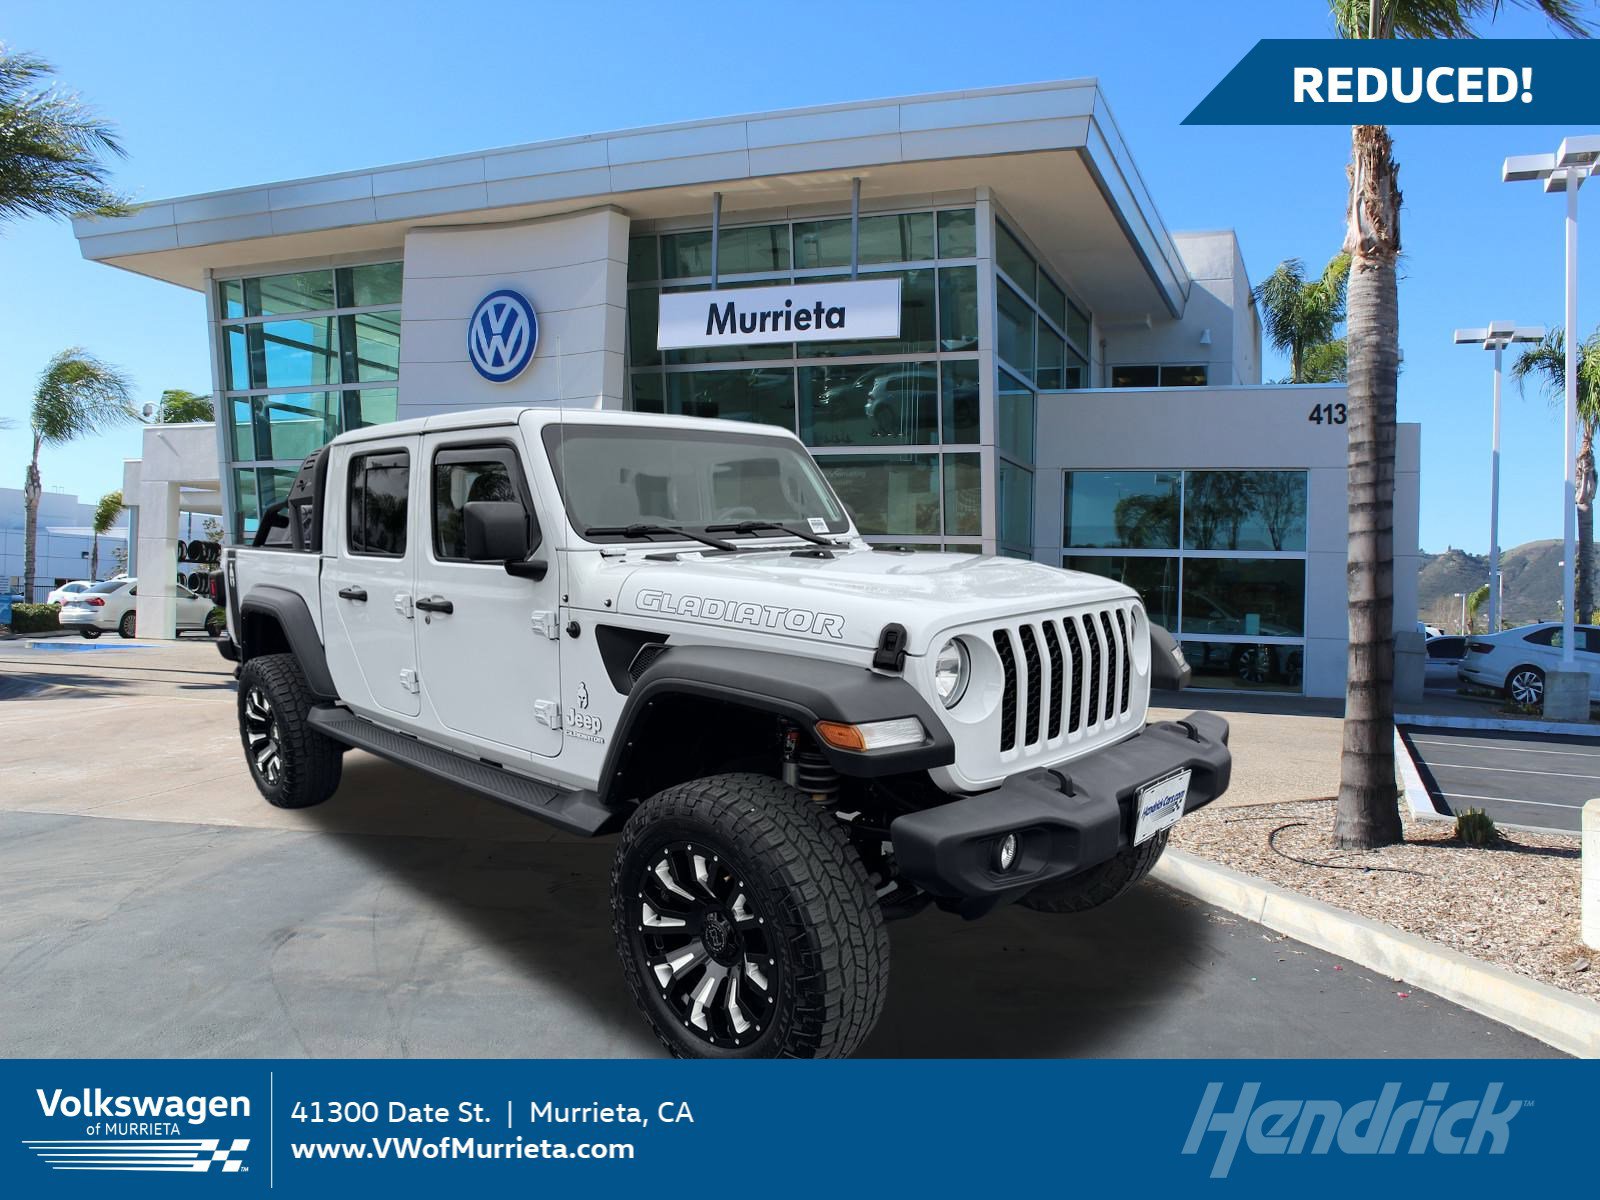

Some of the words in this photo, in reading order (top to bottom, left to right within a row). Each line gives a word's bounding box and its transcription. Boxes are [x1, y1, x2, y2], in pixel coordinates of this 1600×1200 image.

[706, 299, 846, 336] Murrieta
[635, 588, 847, 640] GLADIATOR
[566, 707, 603, 735] Jeep
